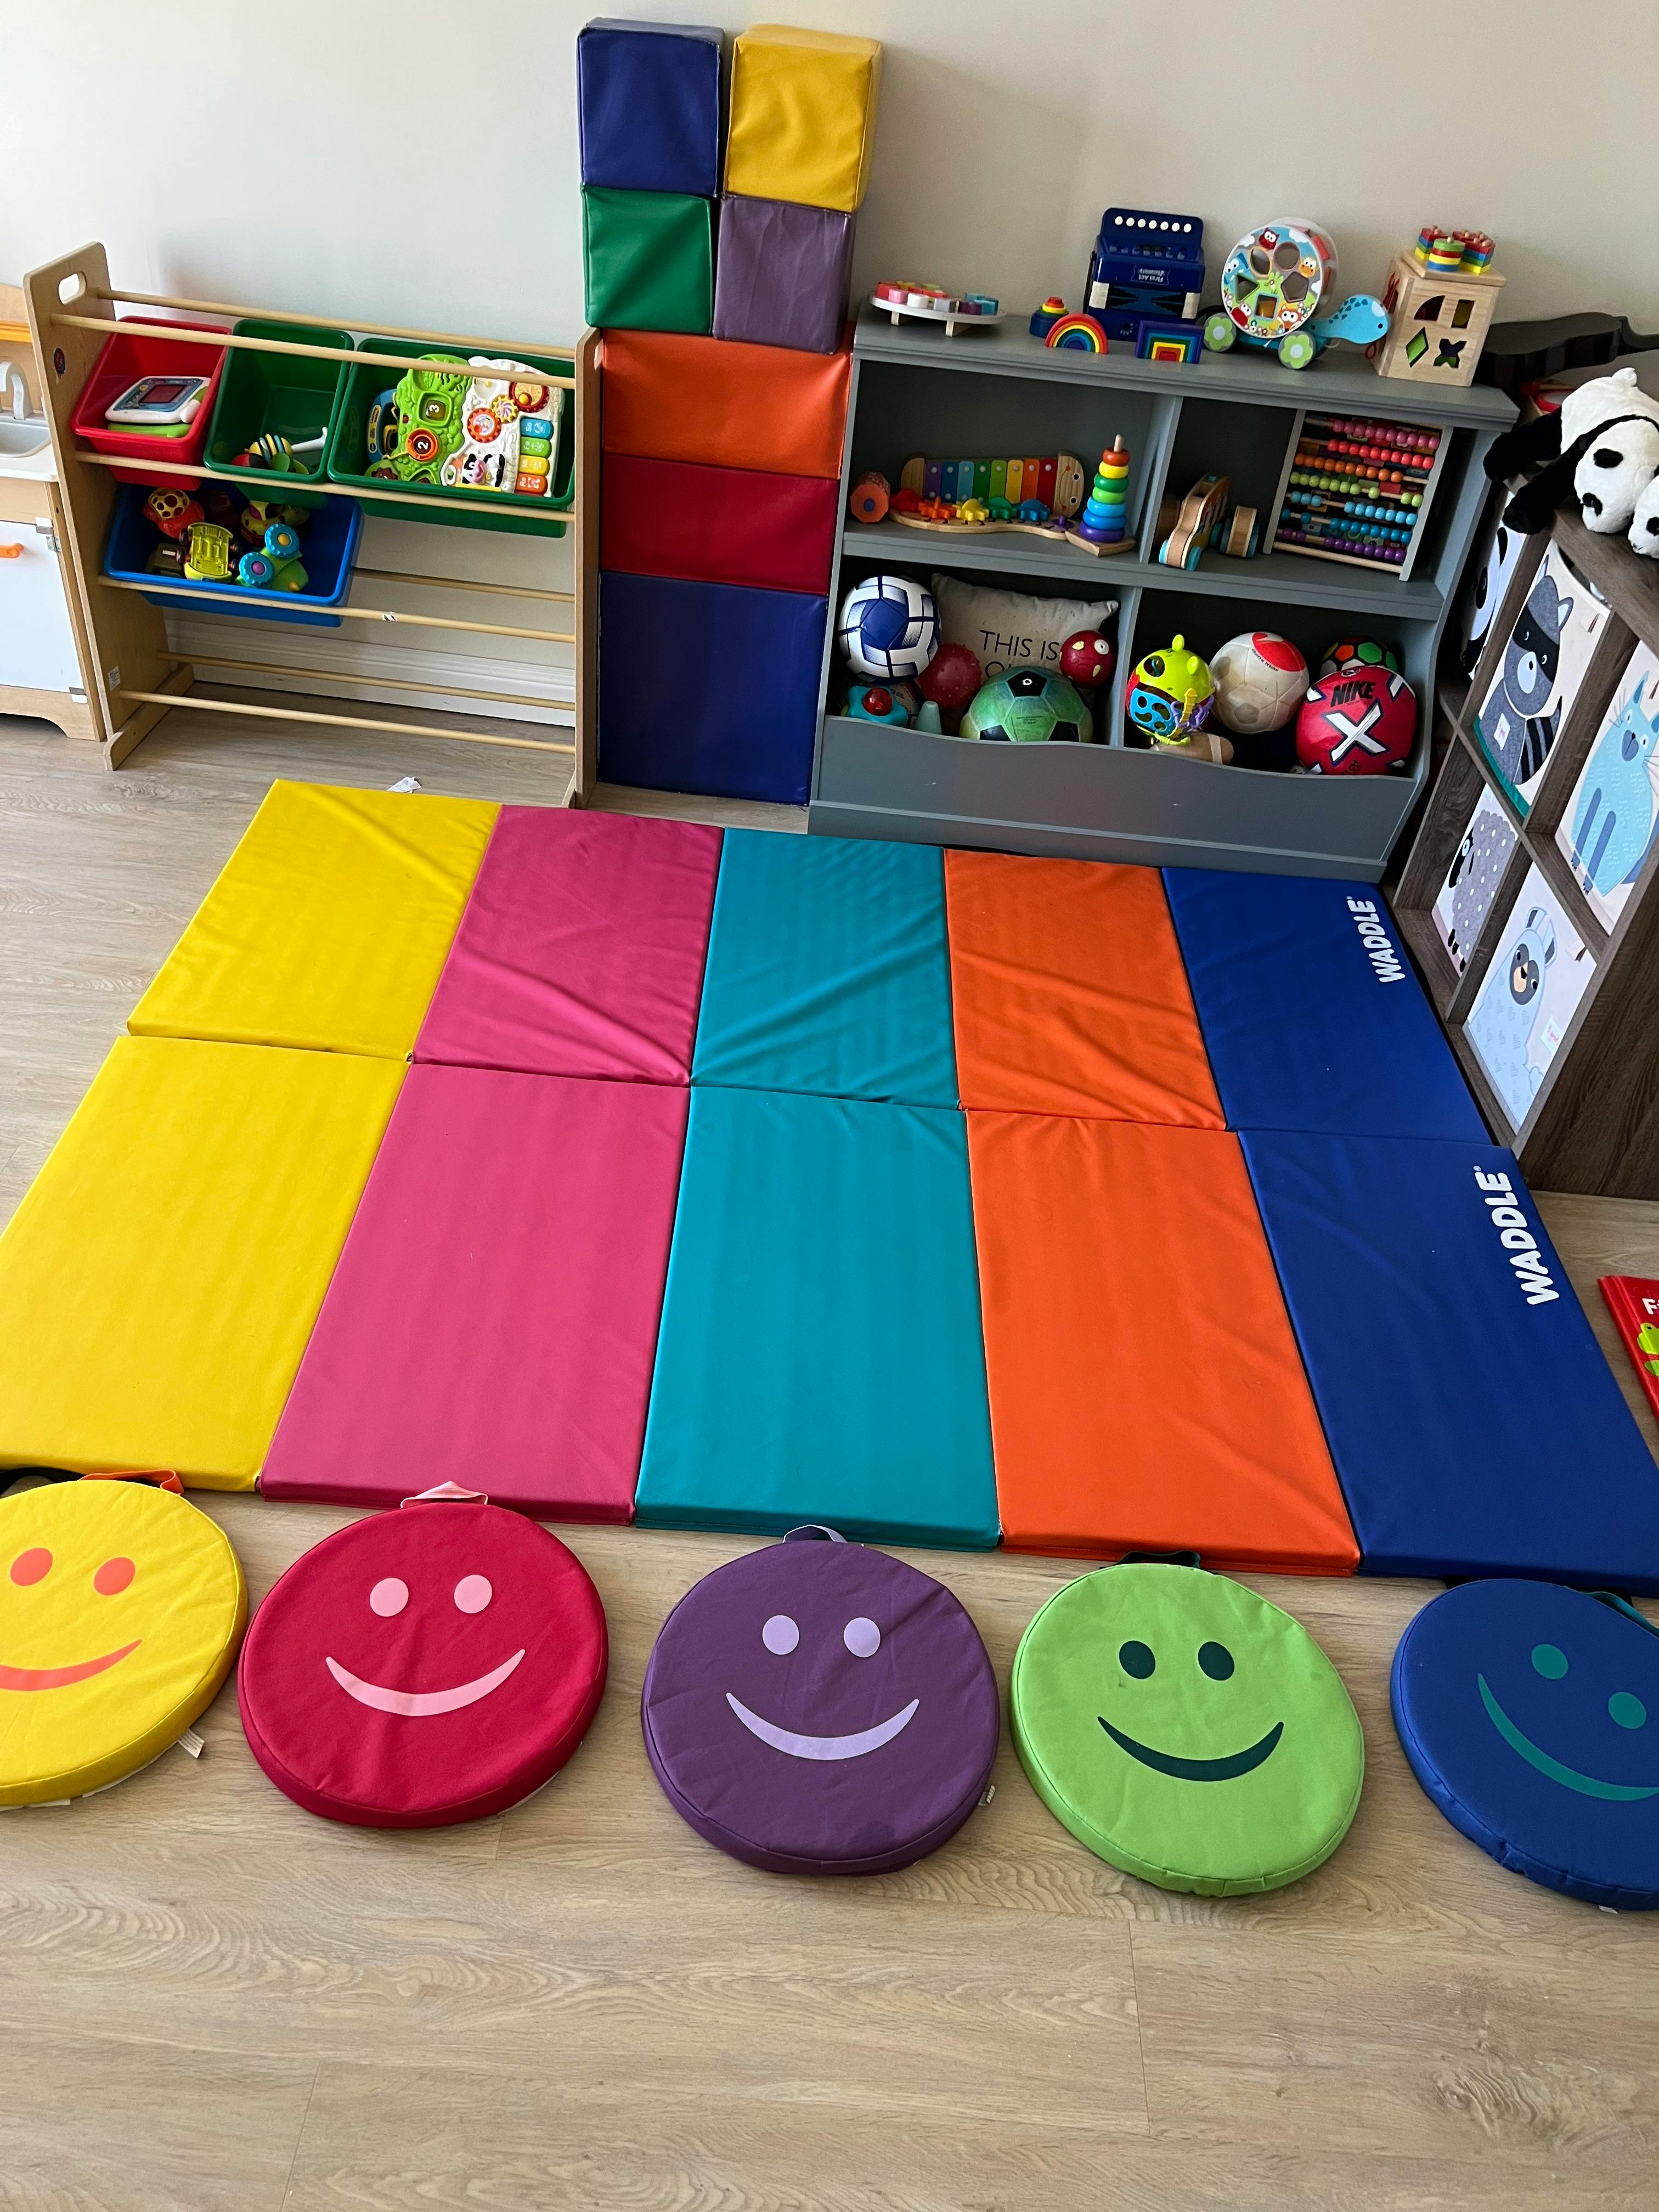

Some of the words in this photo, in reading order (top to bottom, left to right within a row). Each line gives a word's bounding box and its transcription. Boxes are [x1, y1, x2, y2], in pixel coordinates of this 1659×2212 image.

[429, 404, 439, 413] 3
[525, 422, 532, 432] So
[417, 441, 428, 450] 2
[523, 441, 530, 450] Fa
[519, 476, 527, 487] Re
[979, 629, 1033, 657] THIS
[1040, 640, 1060, 661] IS
[1330, 680, 1376, 708] NIKE
[1347, 900, 1406, 983] WADDLE
[1474, 1171, 1560, 1305] WADDLE
[1642, 1297, 1659, 1315] F
